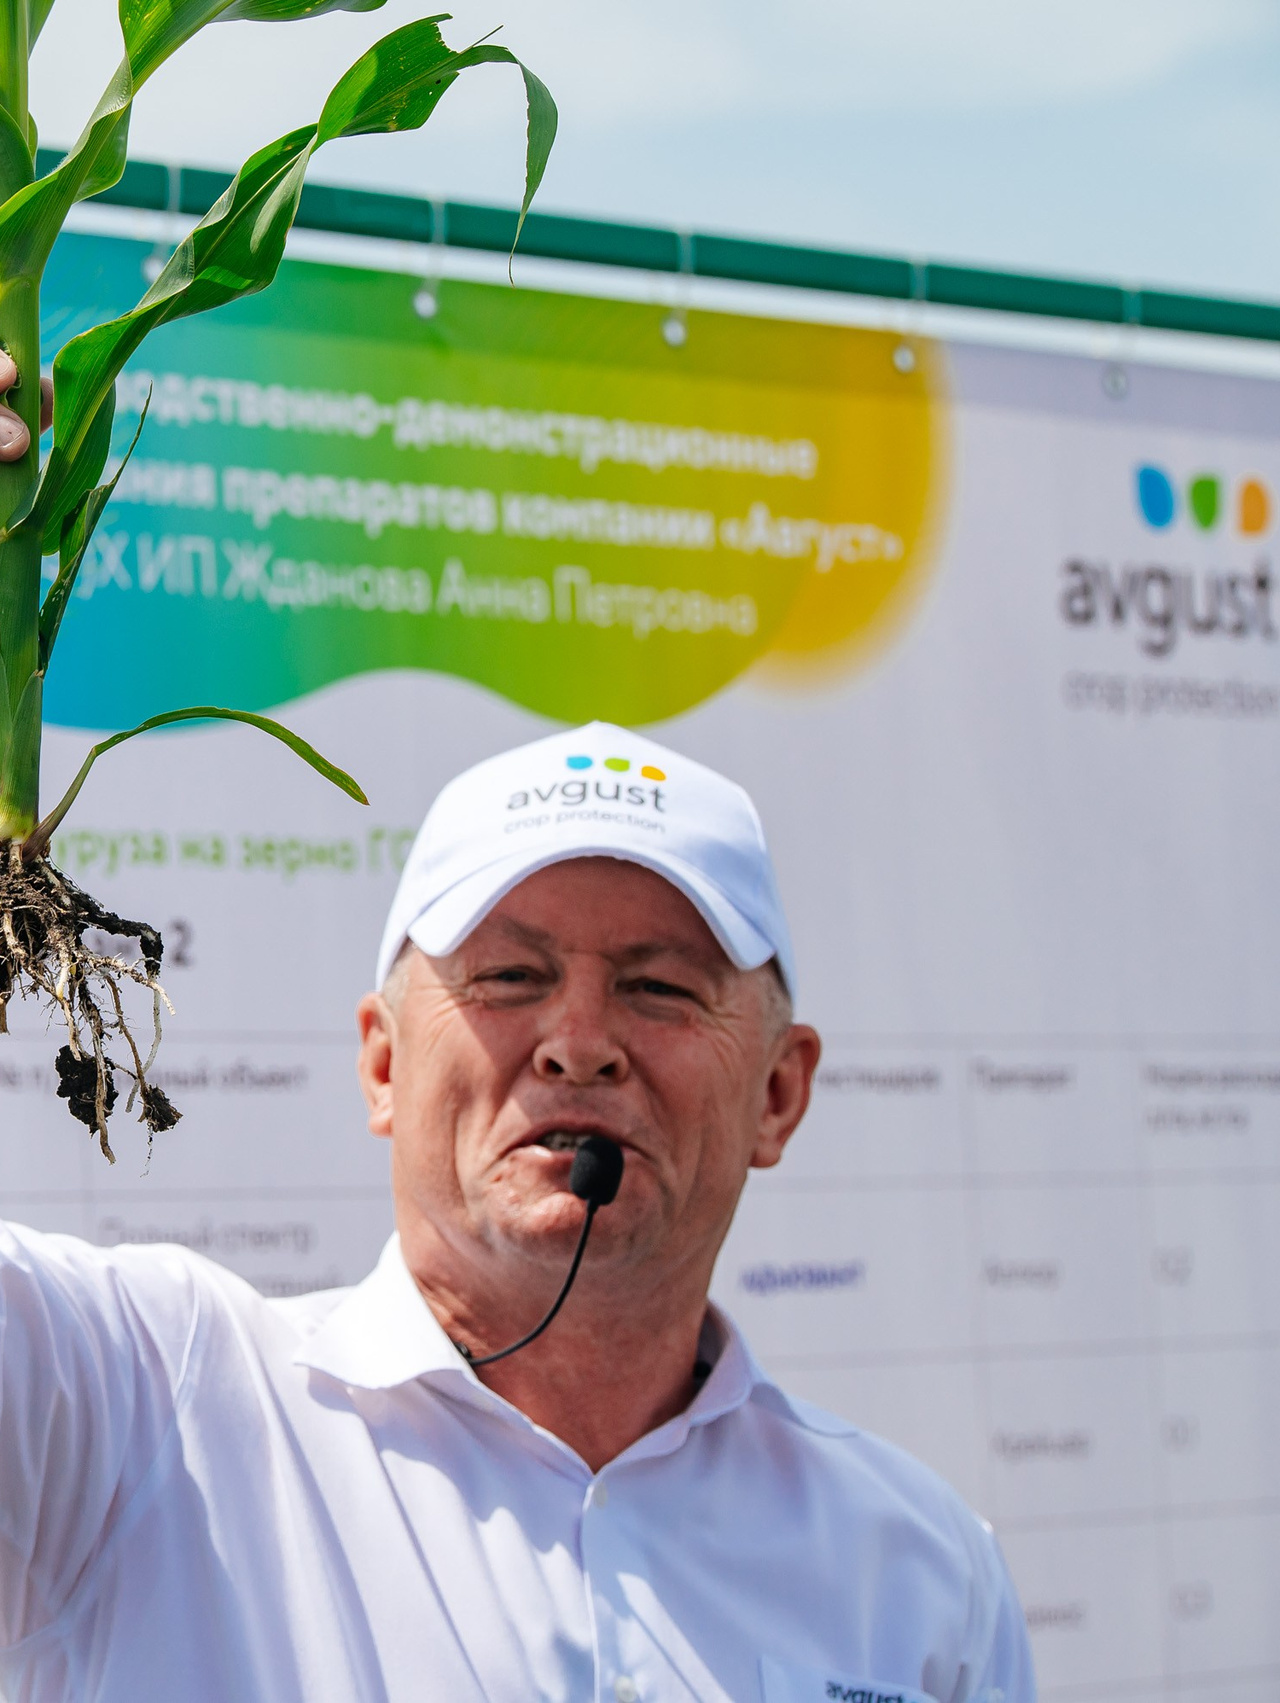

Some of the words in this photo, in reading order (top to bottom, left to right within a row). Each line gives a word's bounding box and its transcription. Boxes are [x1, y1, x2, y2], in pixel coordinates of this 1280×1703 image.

[507, 780, 667, 813] avgust
[505, 813, 551, 834] crop
[556, 810, 666, 834] protection
